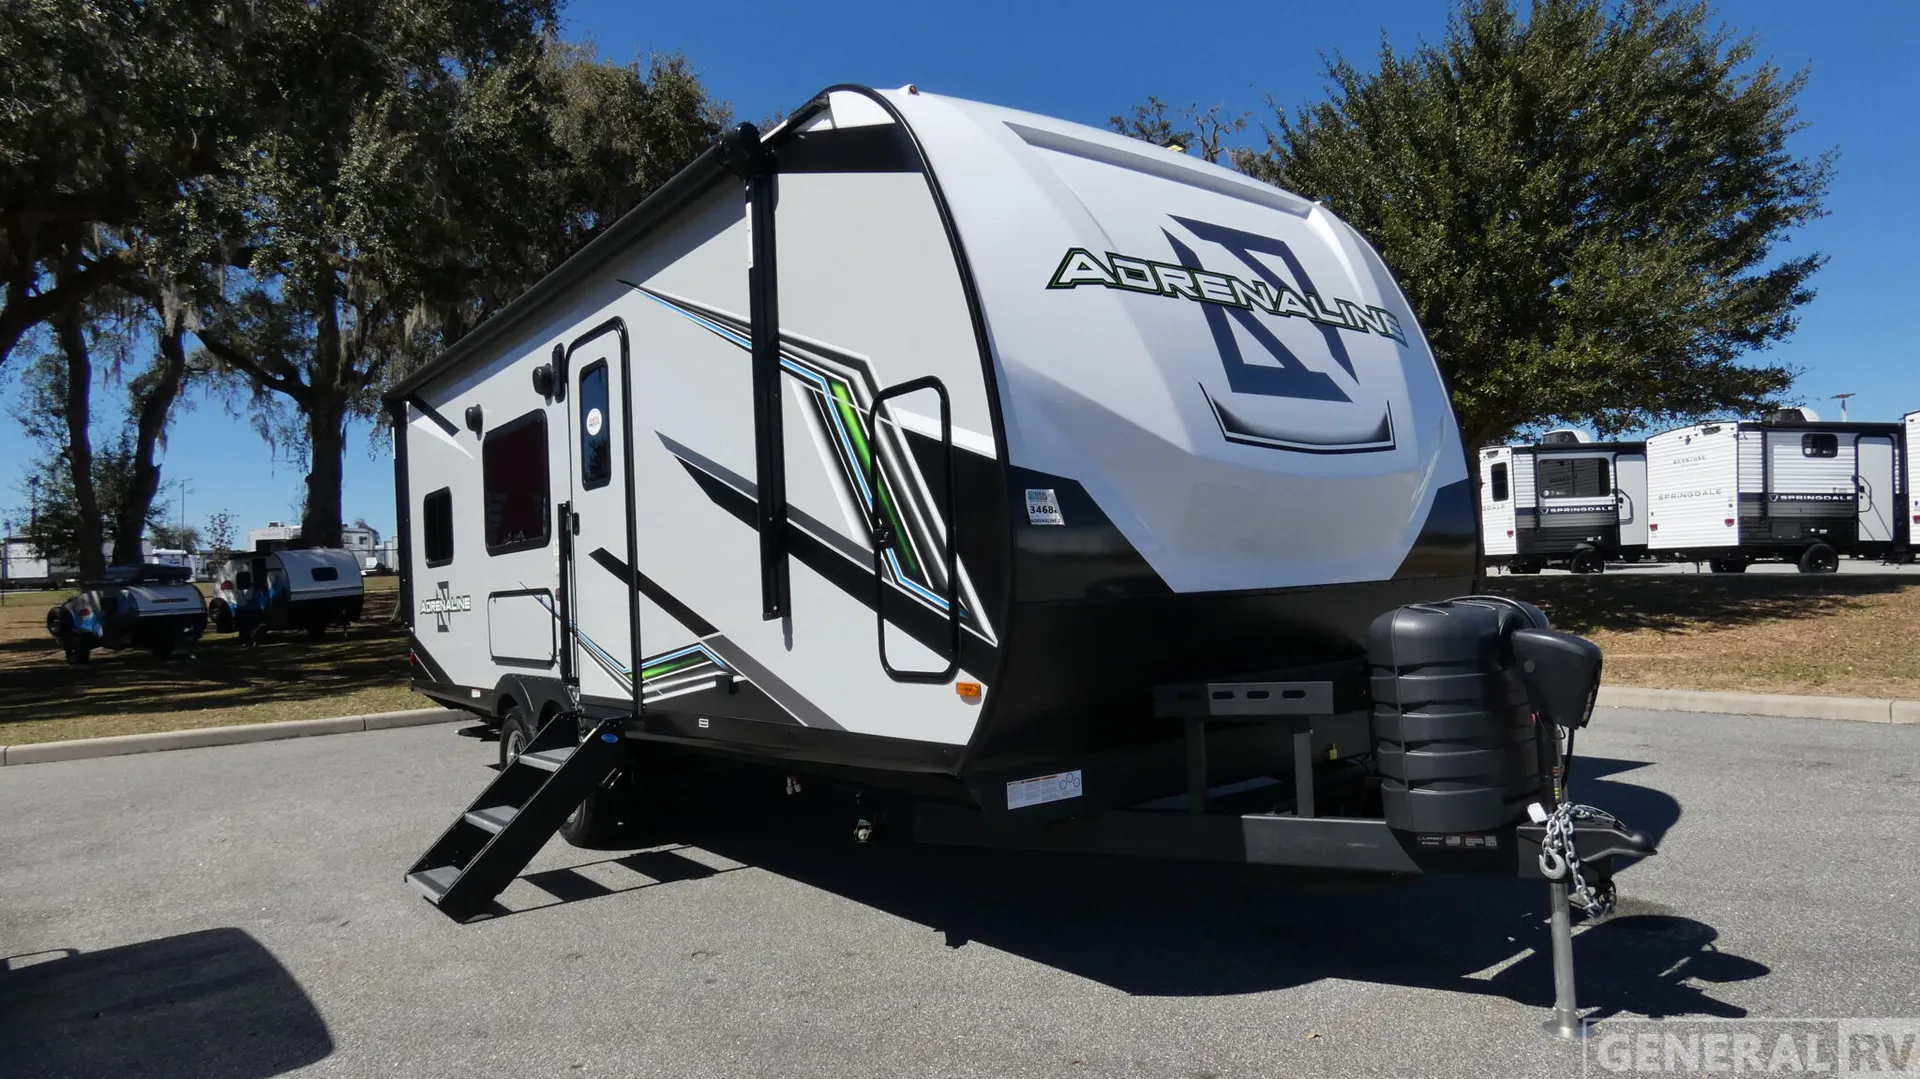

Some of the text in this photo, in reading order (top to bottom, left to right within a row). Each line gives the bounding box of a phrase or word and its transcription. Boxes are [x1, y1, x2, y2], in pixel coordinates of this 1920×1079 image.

[1045, 247, 1409, 348] ADRENALINE
[1658, 488, 1722, 501] SPRINGDALE
[1550, 505, 1615, 514] SPRINGDALE
[420, 595, 471, 615] ADRENALINE
